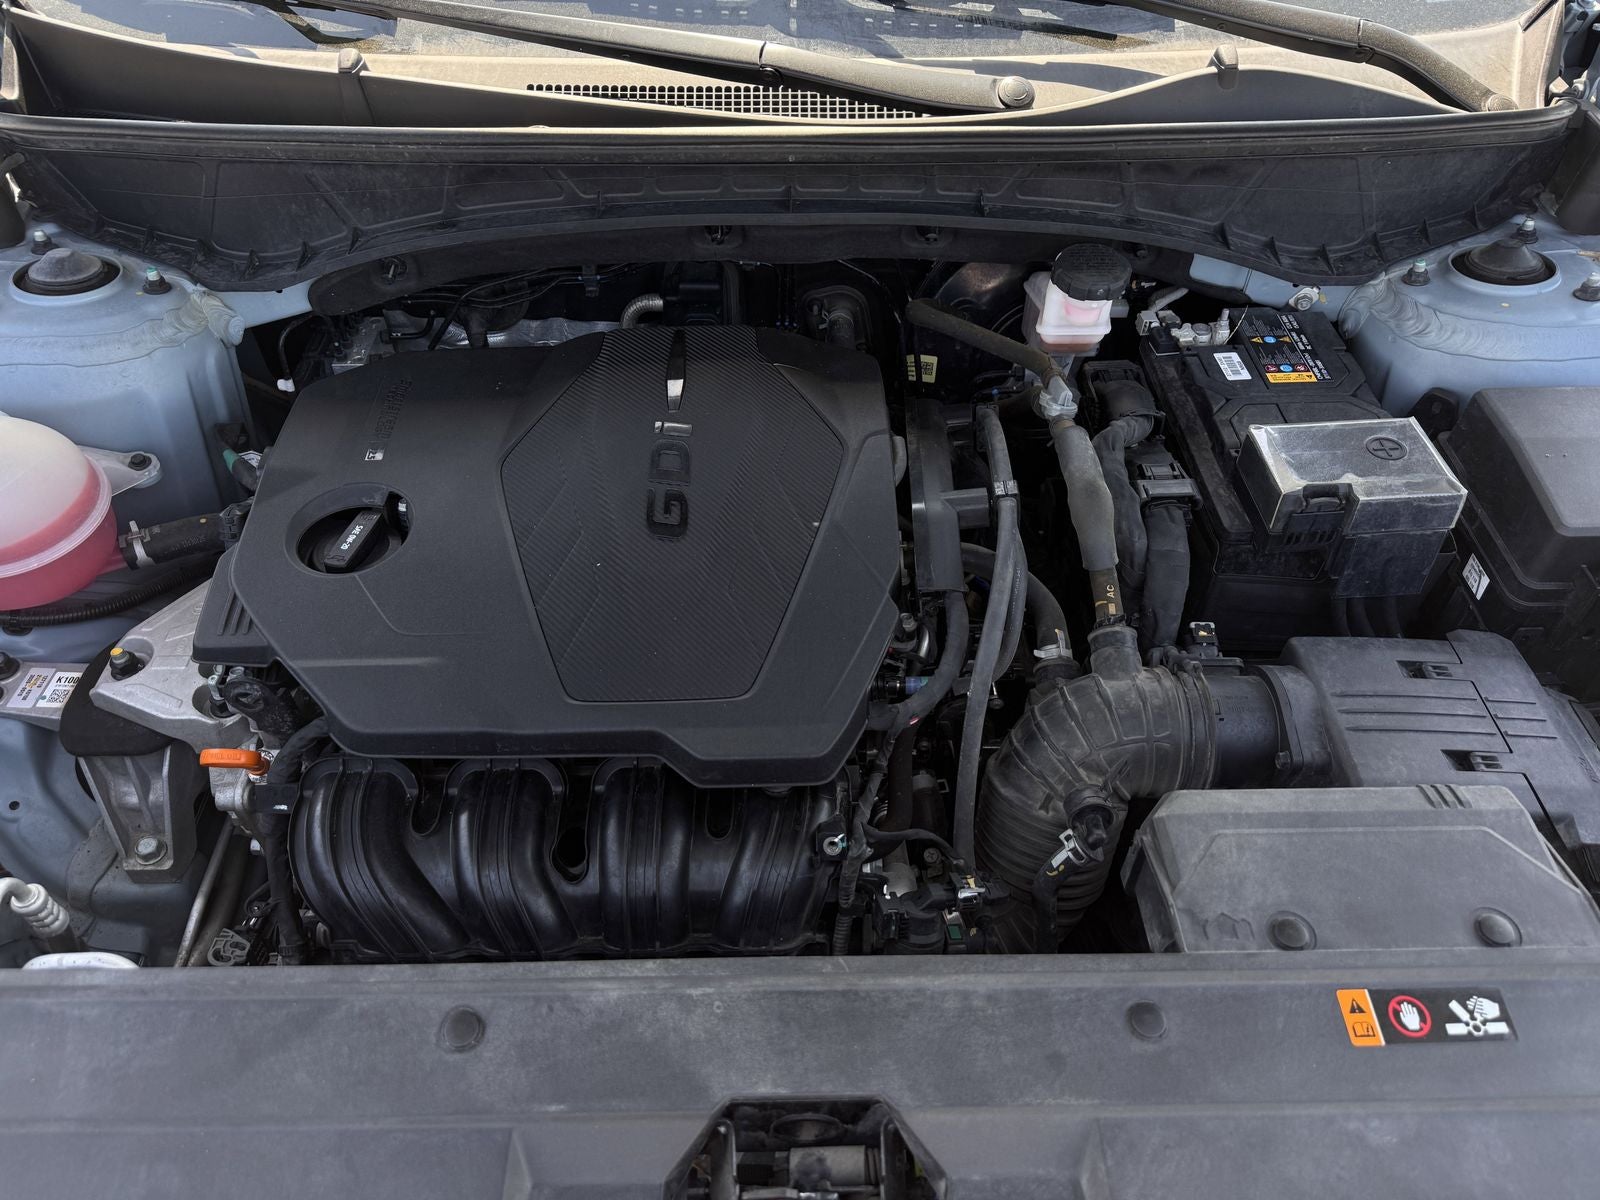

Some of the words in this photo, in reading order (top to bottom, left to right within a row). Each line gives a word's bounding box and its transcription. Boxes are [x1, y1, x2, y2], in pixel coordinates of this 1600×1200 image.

[647, 421, 693, 538] GDi
[351, 524, 364, 535] SAE
[1106, 584, 1115, 599] AC
